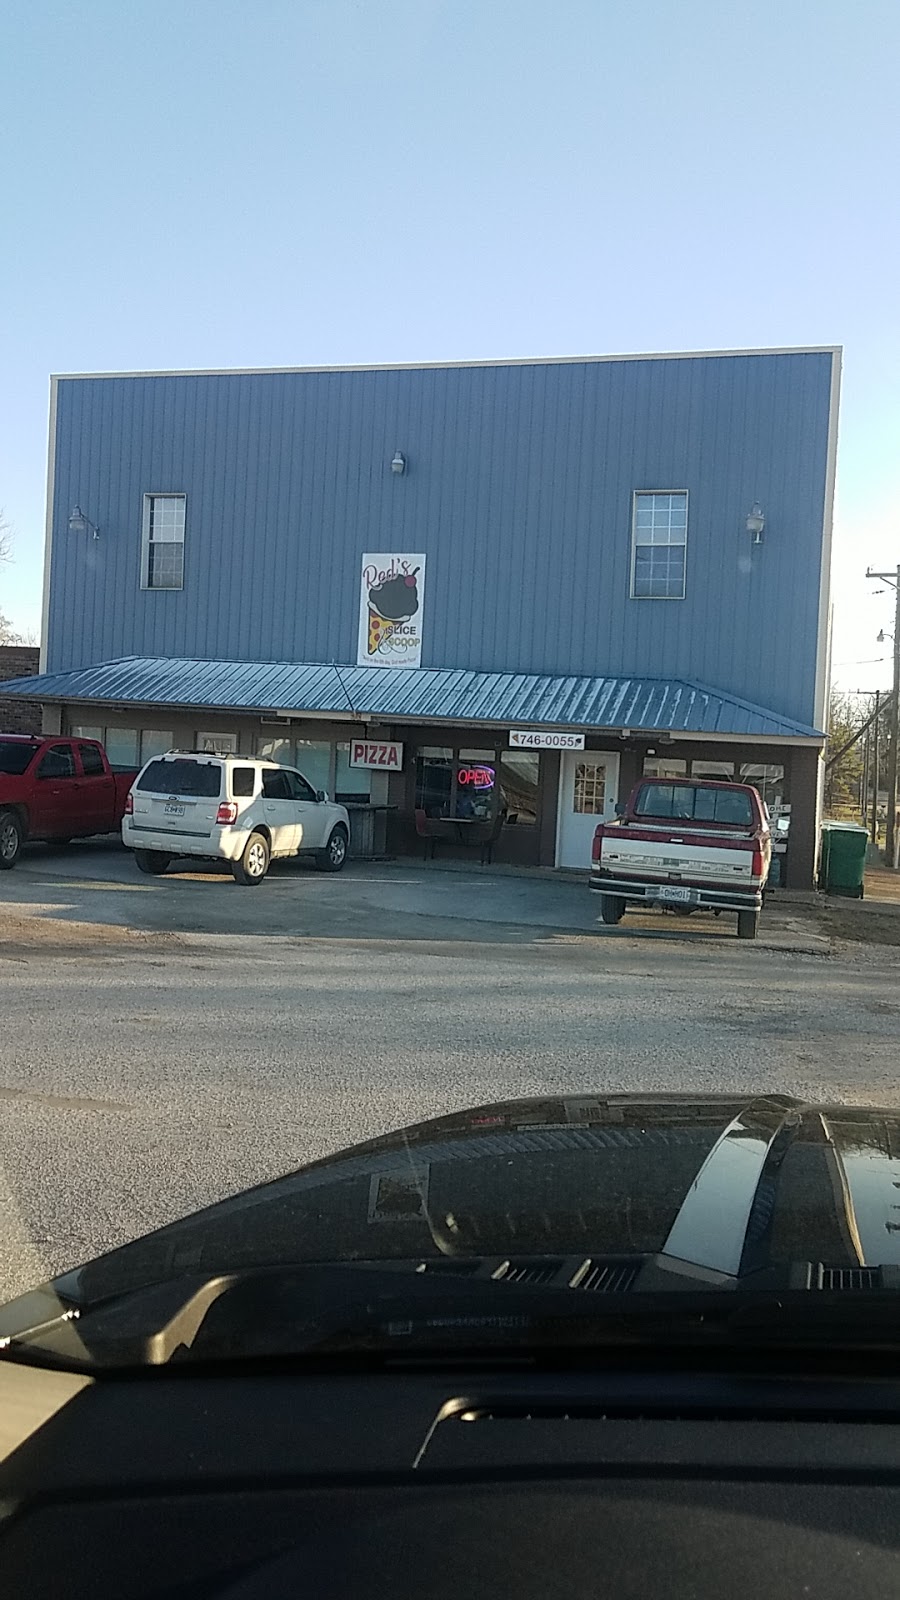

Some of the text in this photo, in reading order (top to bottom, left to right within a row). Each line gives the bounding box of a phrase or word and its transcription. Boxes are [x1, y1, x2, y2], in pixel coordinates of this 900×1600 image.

[362, 557, 411, 590] Red's
[386, 625, 417, 636] SLICE
[388, 637, 420, 648] SCOOP
[520, 734, 575, 747] 746-0055
[353, 744, 398, 766] PIZZA
[458, 769, 492, 785] OPEN
